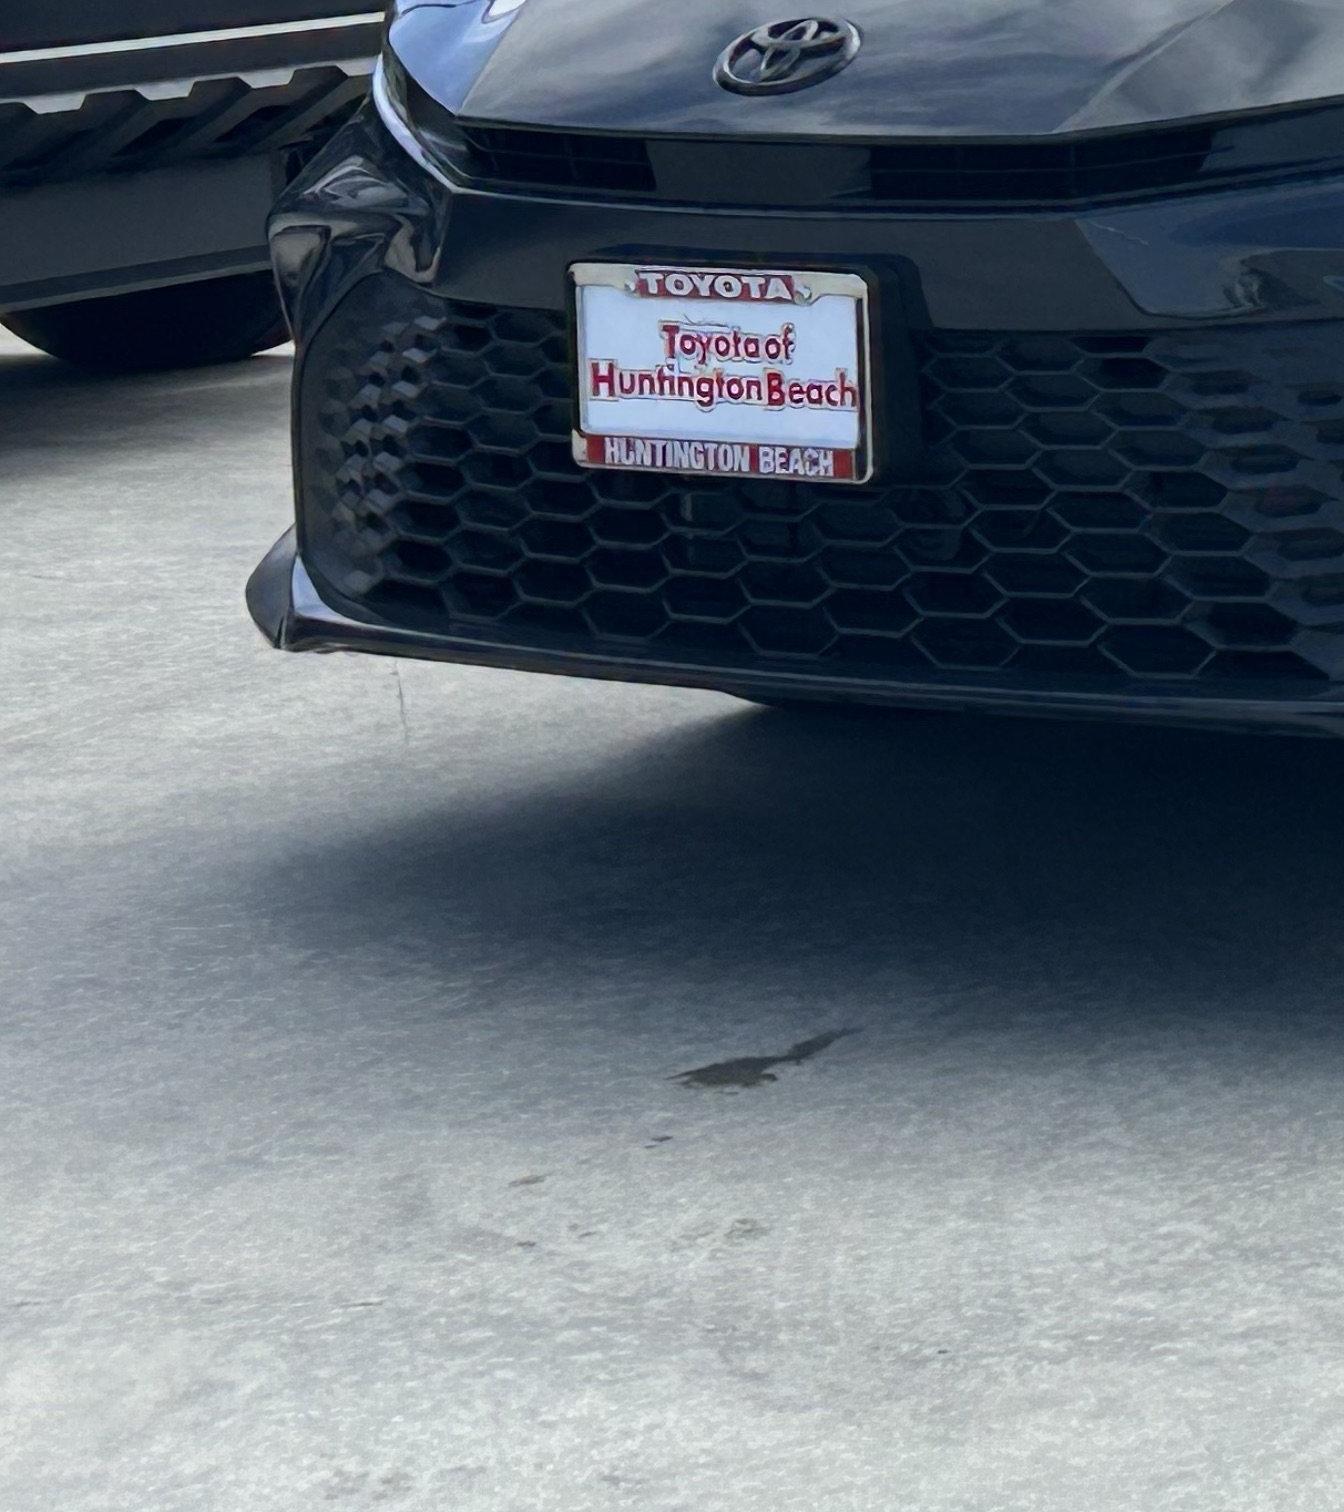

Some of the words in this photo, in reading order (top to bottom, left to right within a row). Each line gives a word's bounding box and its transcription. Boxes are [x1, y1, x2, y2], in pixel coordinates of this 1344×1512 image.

[638, 272, 793, 300] TOYOTA
[662, 324, 762, 364] Toyota
[764, 323, 796, 361] of
[590, 361, 764, 407] Huntington
[766, 368, 858, 408] Beach
[604, 436, 750, 473] HUNTINGTON
[758, 446, 835, 477] BEACH
